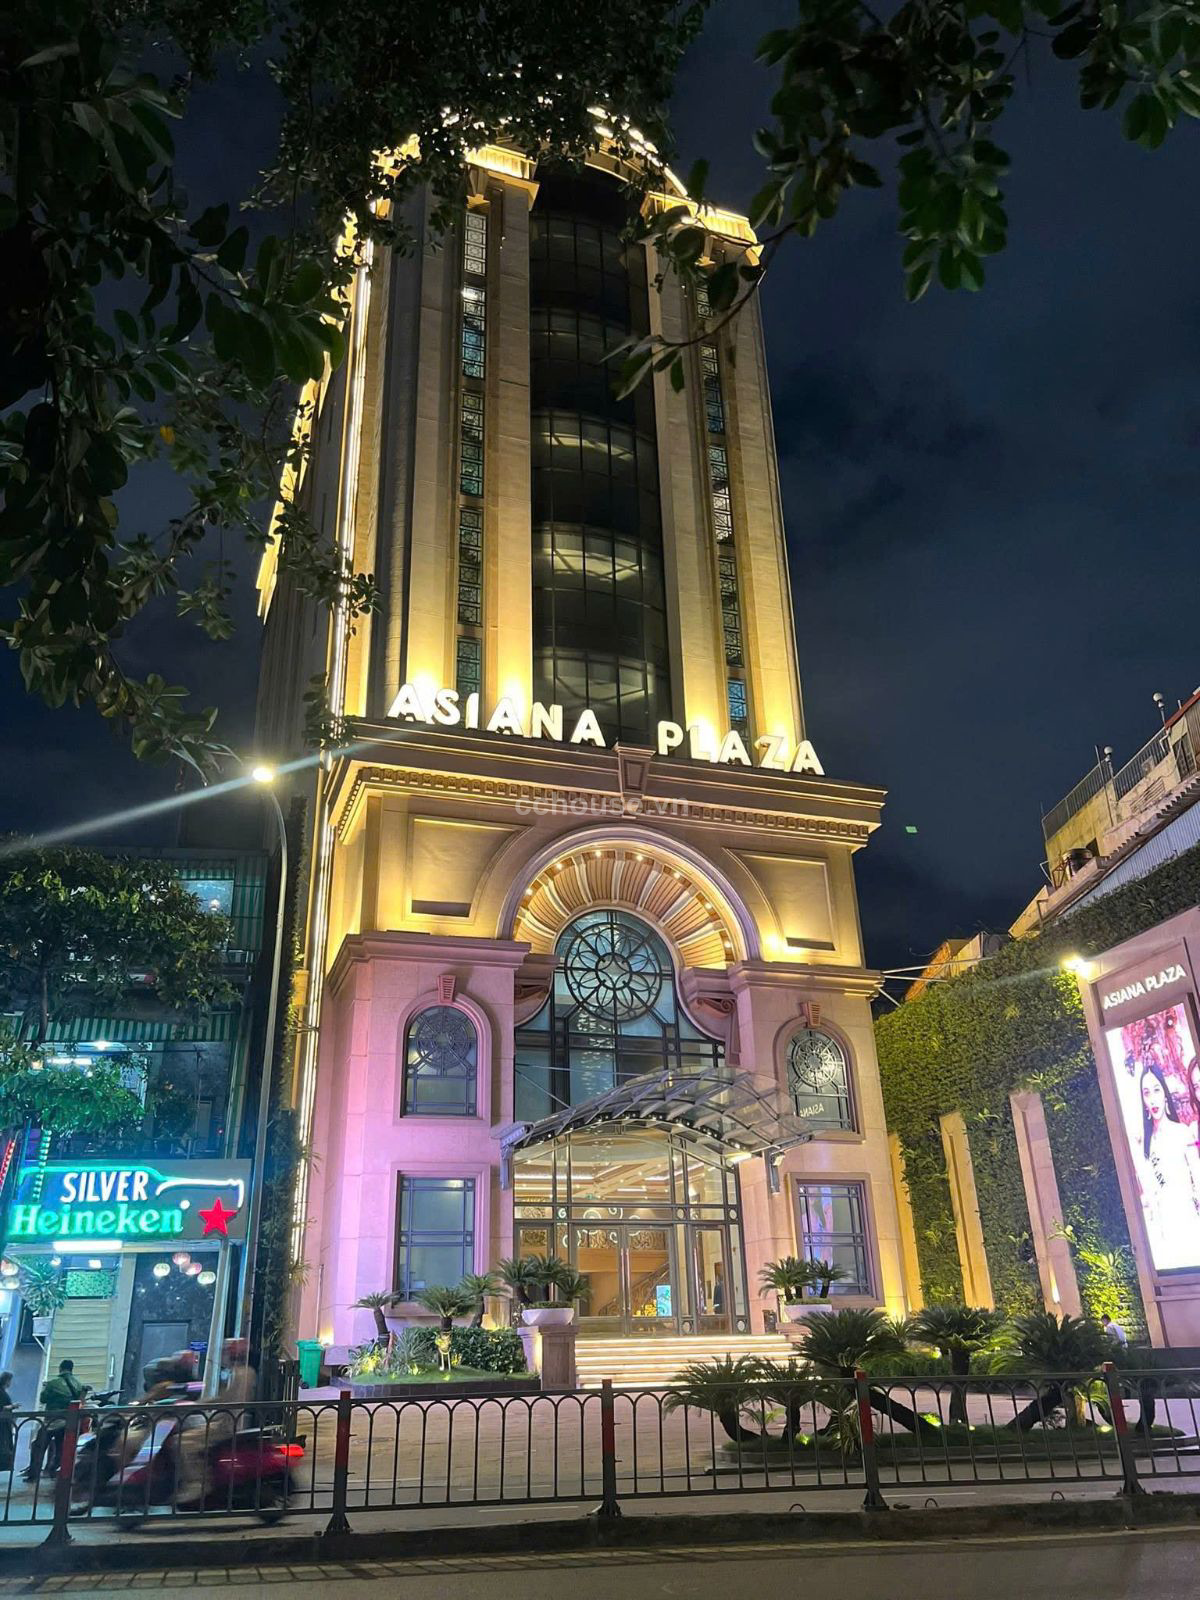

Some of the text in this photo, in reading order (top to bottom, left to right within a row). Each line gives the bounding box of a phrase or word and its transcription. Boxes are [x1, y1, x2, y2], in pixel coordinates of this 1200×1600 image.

[385, 683, 826, 776] ASIANA PLAZA
[1103, 964, 1187, 1010] ASIANA PLAZA
[60, 1170, 149, 1203] SILVER
[8, 1202, 184, 1236] Heineken
